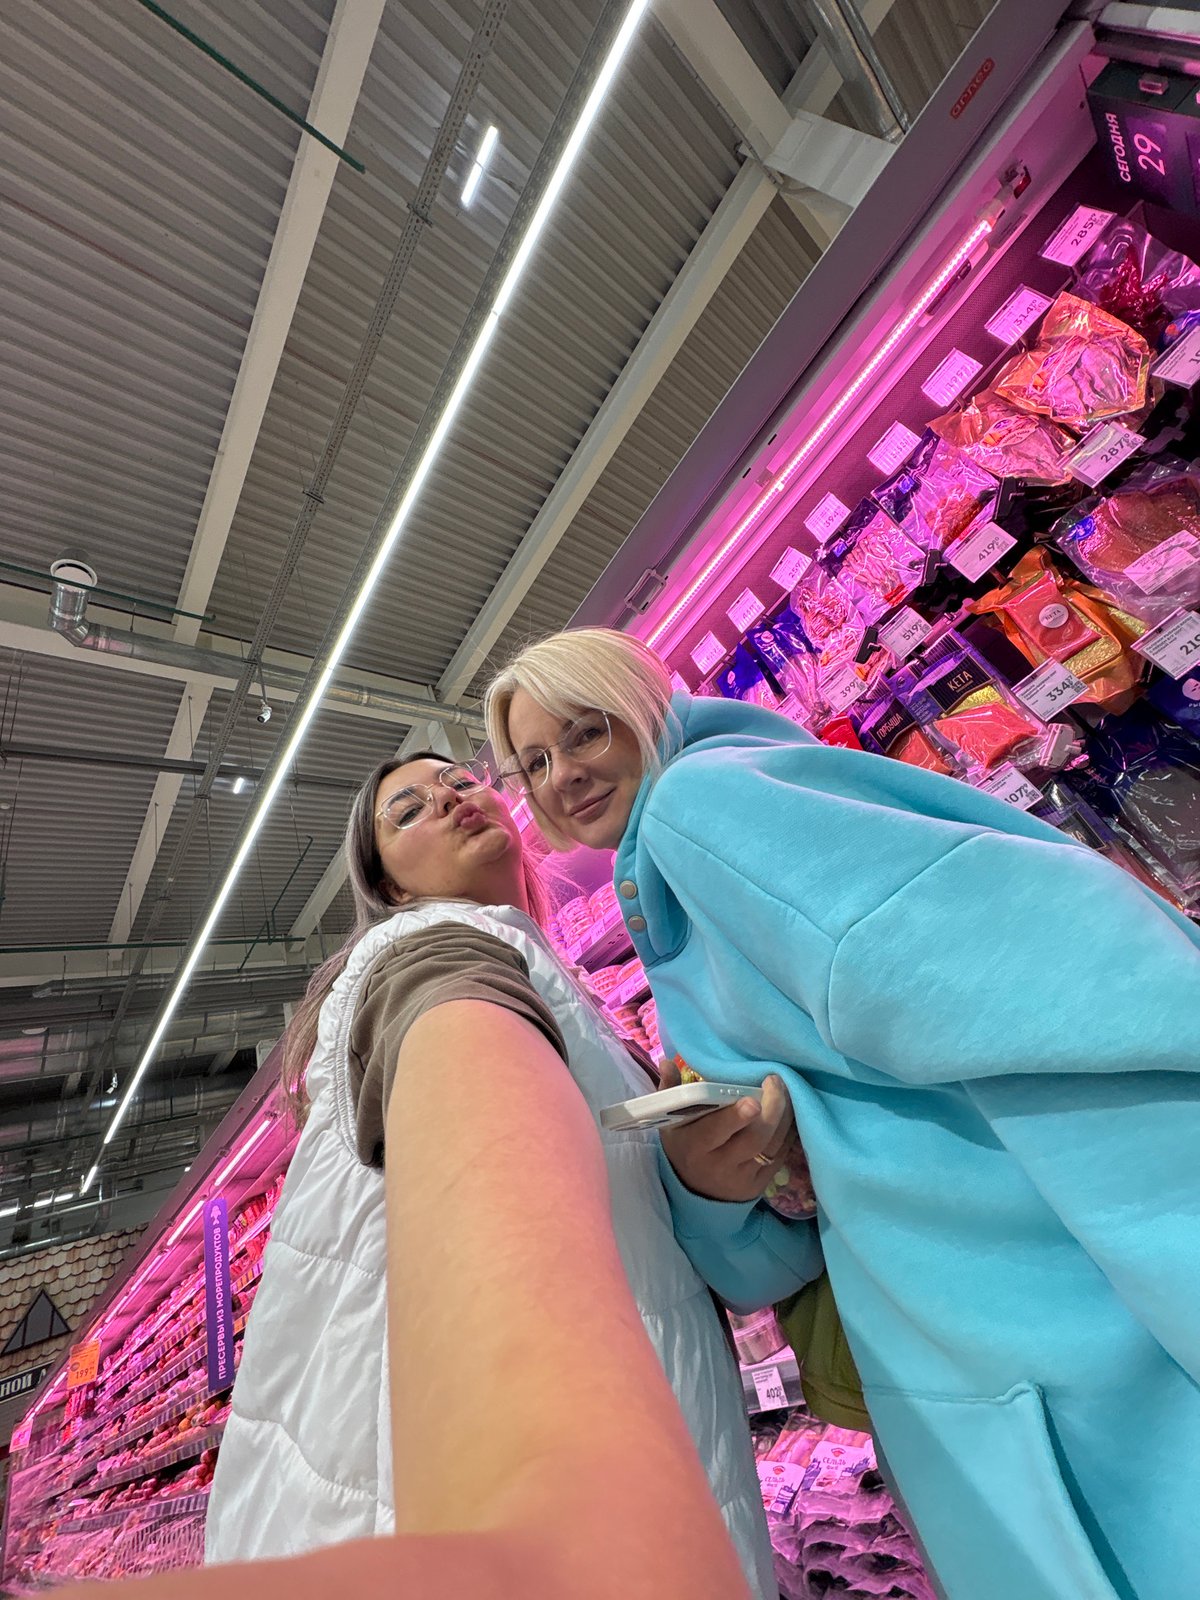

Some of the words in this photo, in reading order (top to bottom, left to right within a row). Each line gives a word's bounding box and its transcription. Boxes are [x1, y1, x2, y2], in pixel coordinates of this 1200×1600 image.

[1105, 112, 1132, 182] СЕГОДНЯ
[1134, 133, 1166, 176] 29
[1071, 220, 1094, 246] 285
[1100, 436, 1124, 463] 287
[978, 542, 996, 561] 419
[902, 624, 919, 641] 519
[947, 670, 973, 691] КЕТА
[1046, 681, 1071, 702] 334
[876, 713, 904, 740] ГОРБУША
[213, 1227, 224, 1309] МОРЕПРОДУКТОВ
[216, 1309, 225, 1323] ИЗ
[216, 1323, 227, 1380] ПРЕСЕРВЫ
[766, 1387, 780, 1399] 402
[822, 1456, 847, 1467] СЕЛЬДЬ
